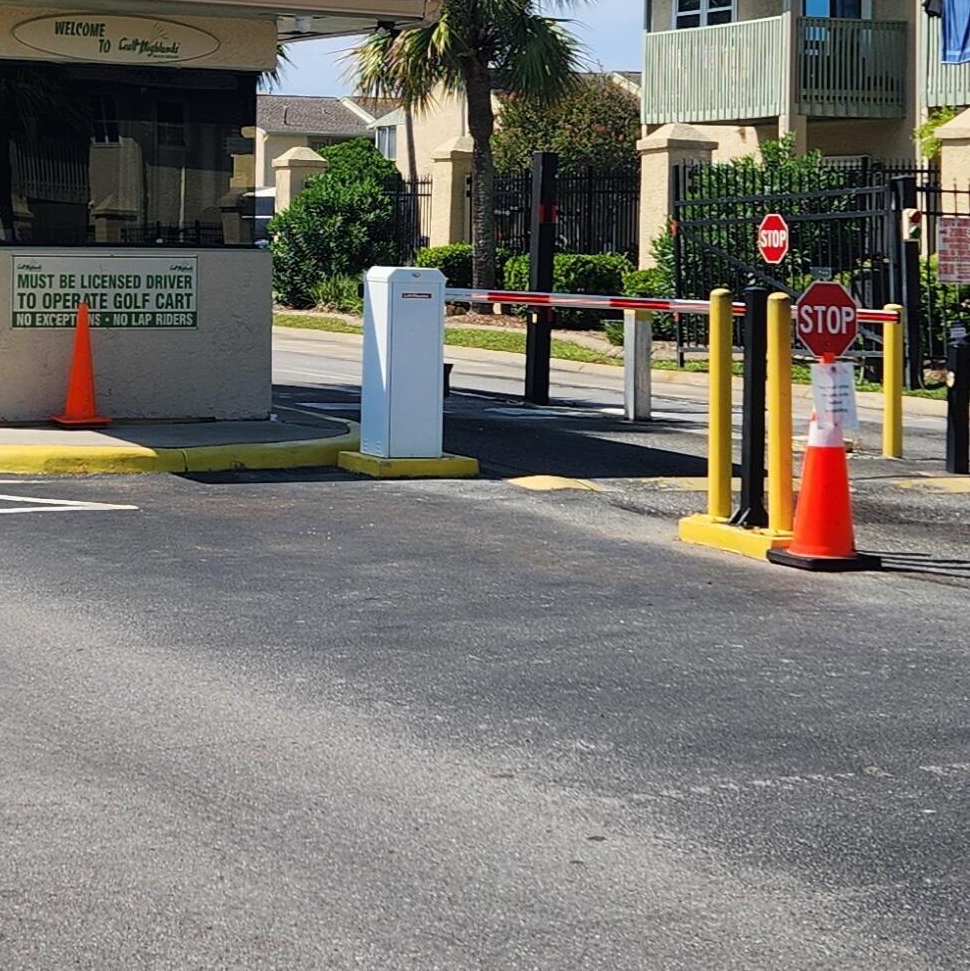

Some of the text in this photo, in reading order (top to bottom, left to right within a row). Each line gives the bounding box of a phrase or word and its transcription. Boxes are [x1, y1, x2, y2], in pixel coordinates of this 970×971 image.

[54, 21, 106, 38] WELCOME
[98, 39, 111, 54] TO
[759, 229, 786, 248] STOP
[17, 274, 192, 289] MUST BE LICENSED DRIVER
[17, 293, 193, 309] TO OPERATE GOLF CART
[16, 313, 193, 326] NO EXCEPTNS NO LAP RIDERS
[799, 304, 855, 335] STOP
